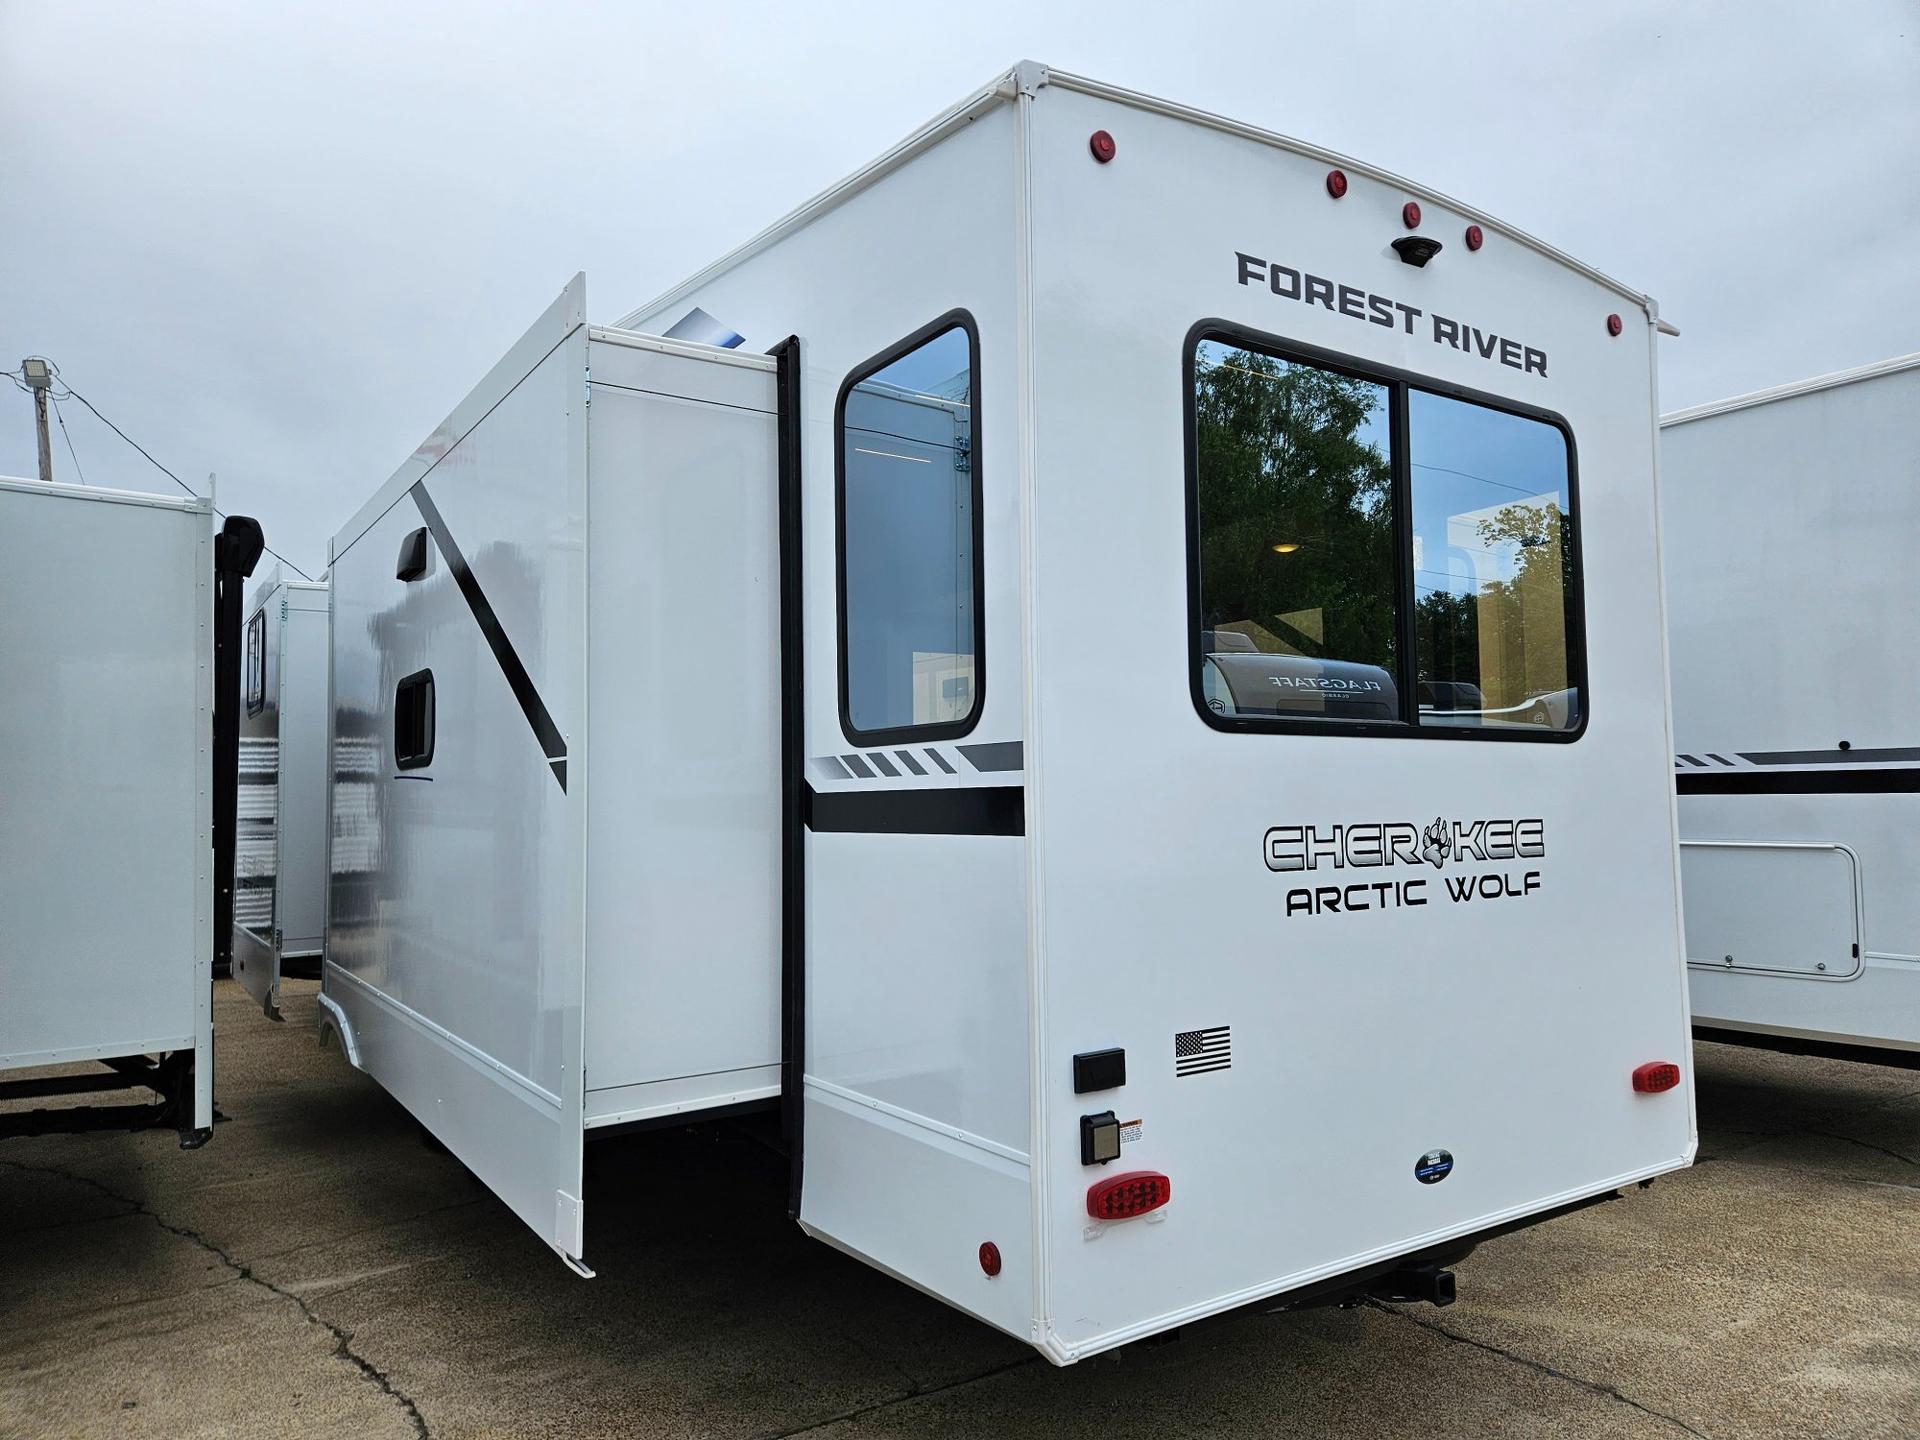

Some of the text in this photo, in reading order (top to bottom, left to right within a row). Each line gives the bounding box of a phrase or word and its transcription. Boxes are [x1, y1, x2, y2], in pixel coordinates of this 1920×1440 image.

[1234, 251, 1548, 378] FOREST RIVER
[1286, 871, 1541, 917] ARCTIC WOLF
